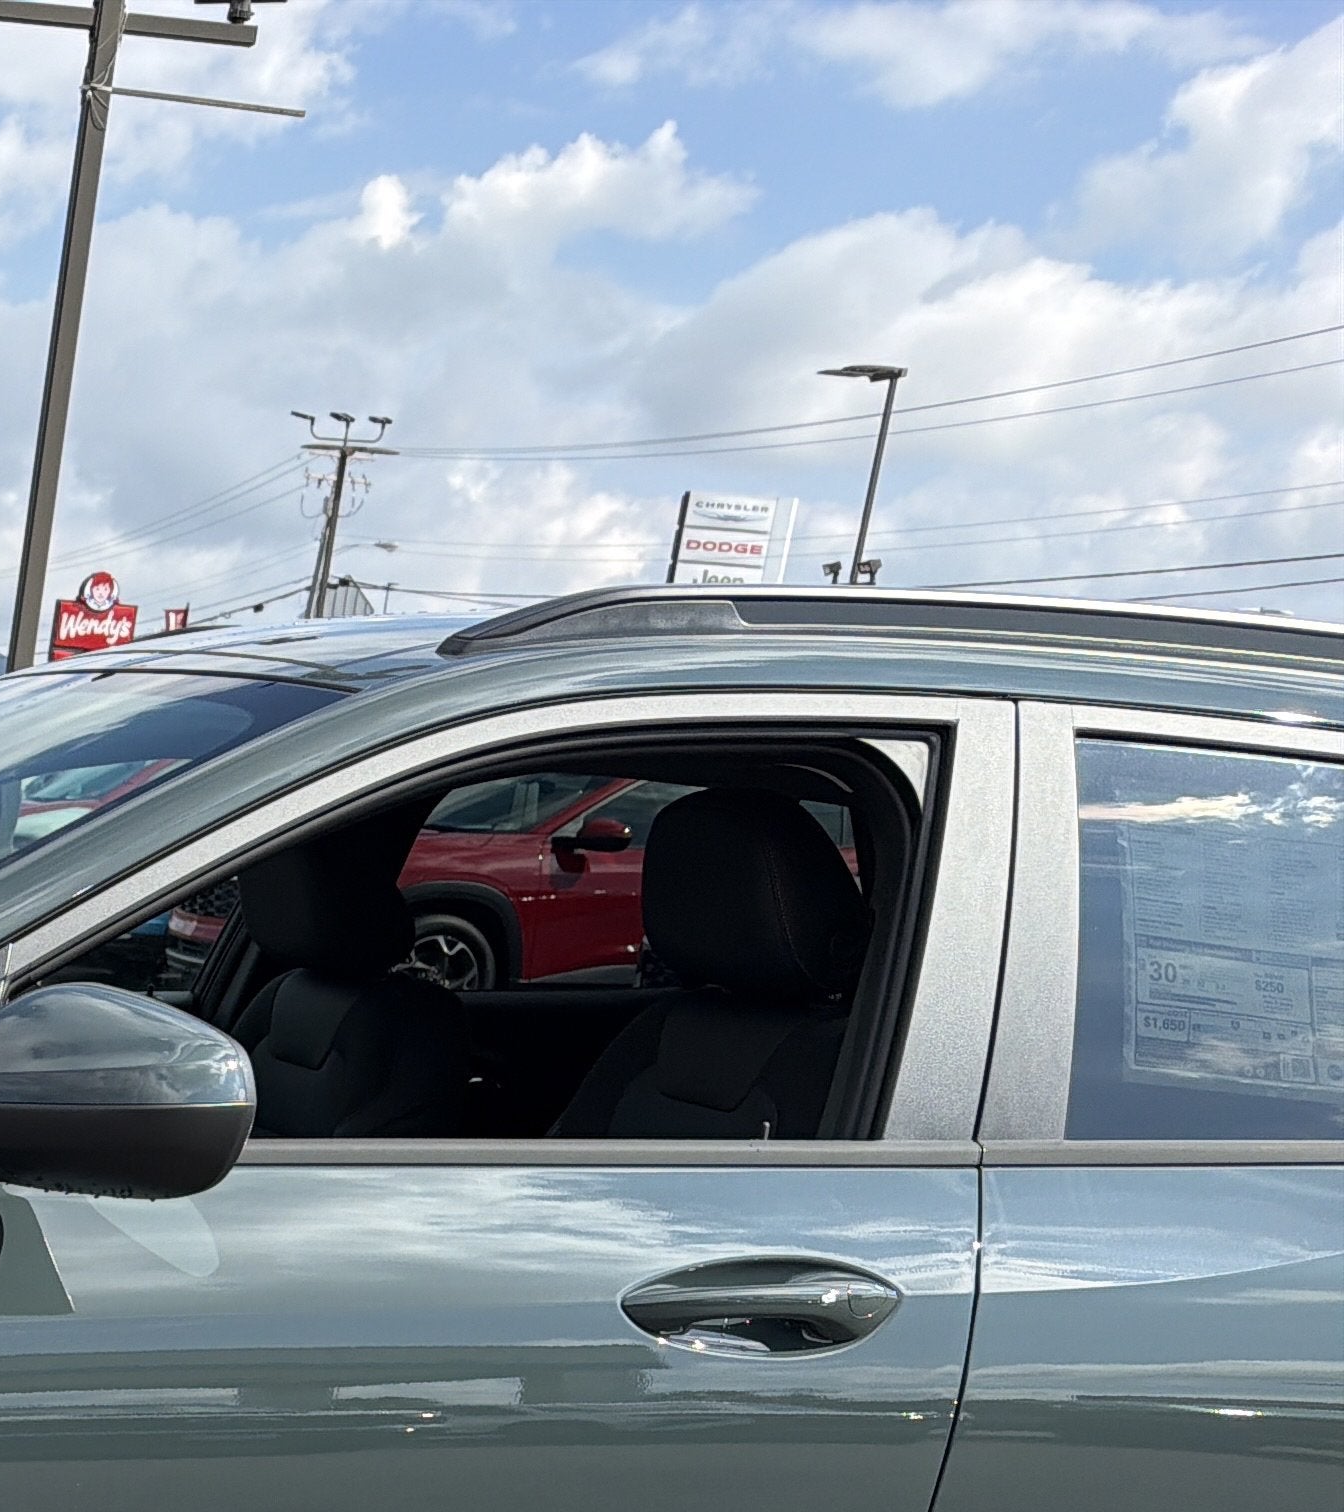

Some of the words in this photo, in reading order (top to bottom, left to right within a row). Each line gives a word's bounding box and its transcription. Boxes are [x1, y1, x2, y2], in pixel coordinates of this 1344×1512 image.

[694, 501, 770, 513] CHRYSLER
[685, 539, 764, 555] DODGE
[59, 609, 133, 645] Wendy's
[1148, 960, 1178, 984] 30
[1254, 979, 1285, 995] $250
[1143, 1015, 1186, 1032] $1,650
